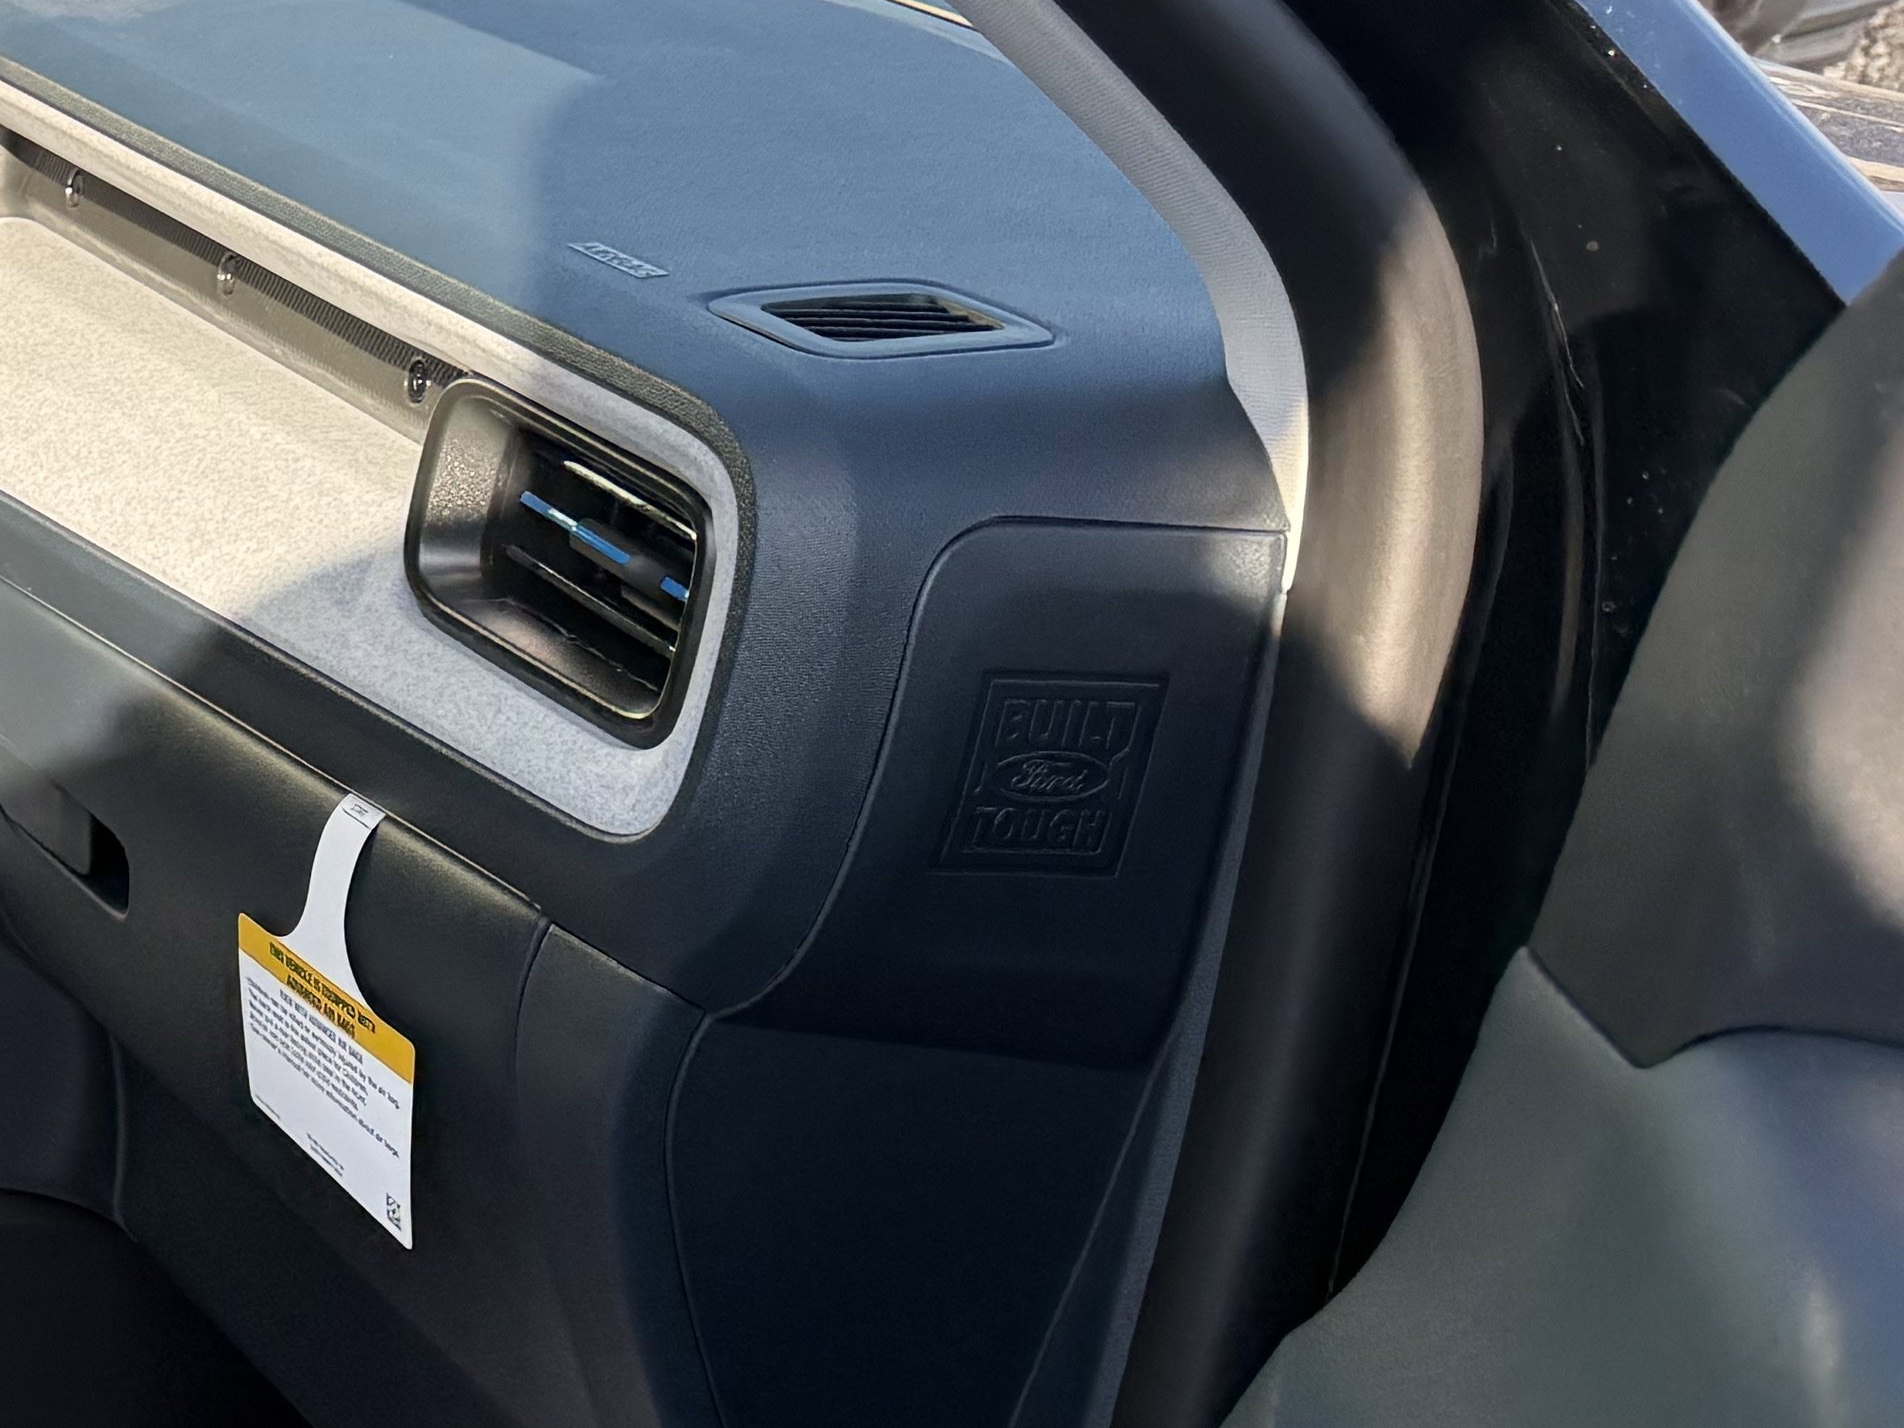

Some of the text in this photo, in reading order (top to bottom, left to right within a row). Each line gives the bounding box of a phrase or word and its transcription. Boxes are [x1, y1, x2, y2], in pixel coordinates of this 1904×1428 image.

[994, 699, 1135, 750] BUILT
[1011, 758, 1087, 790] Ford
[971, 806, 1110, 849] TOUGH
